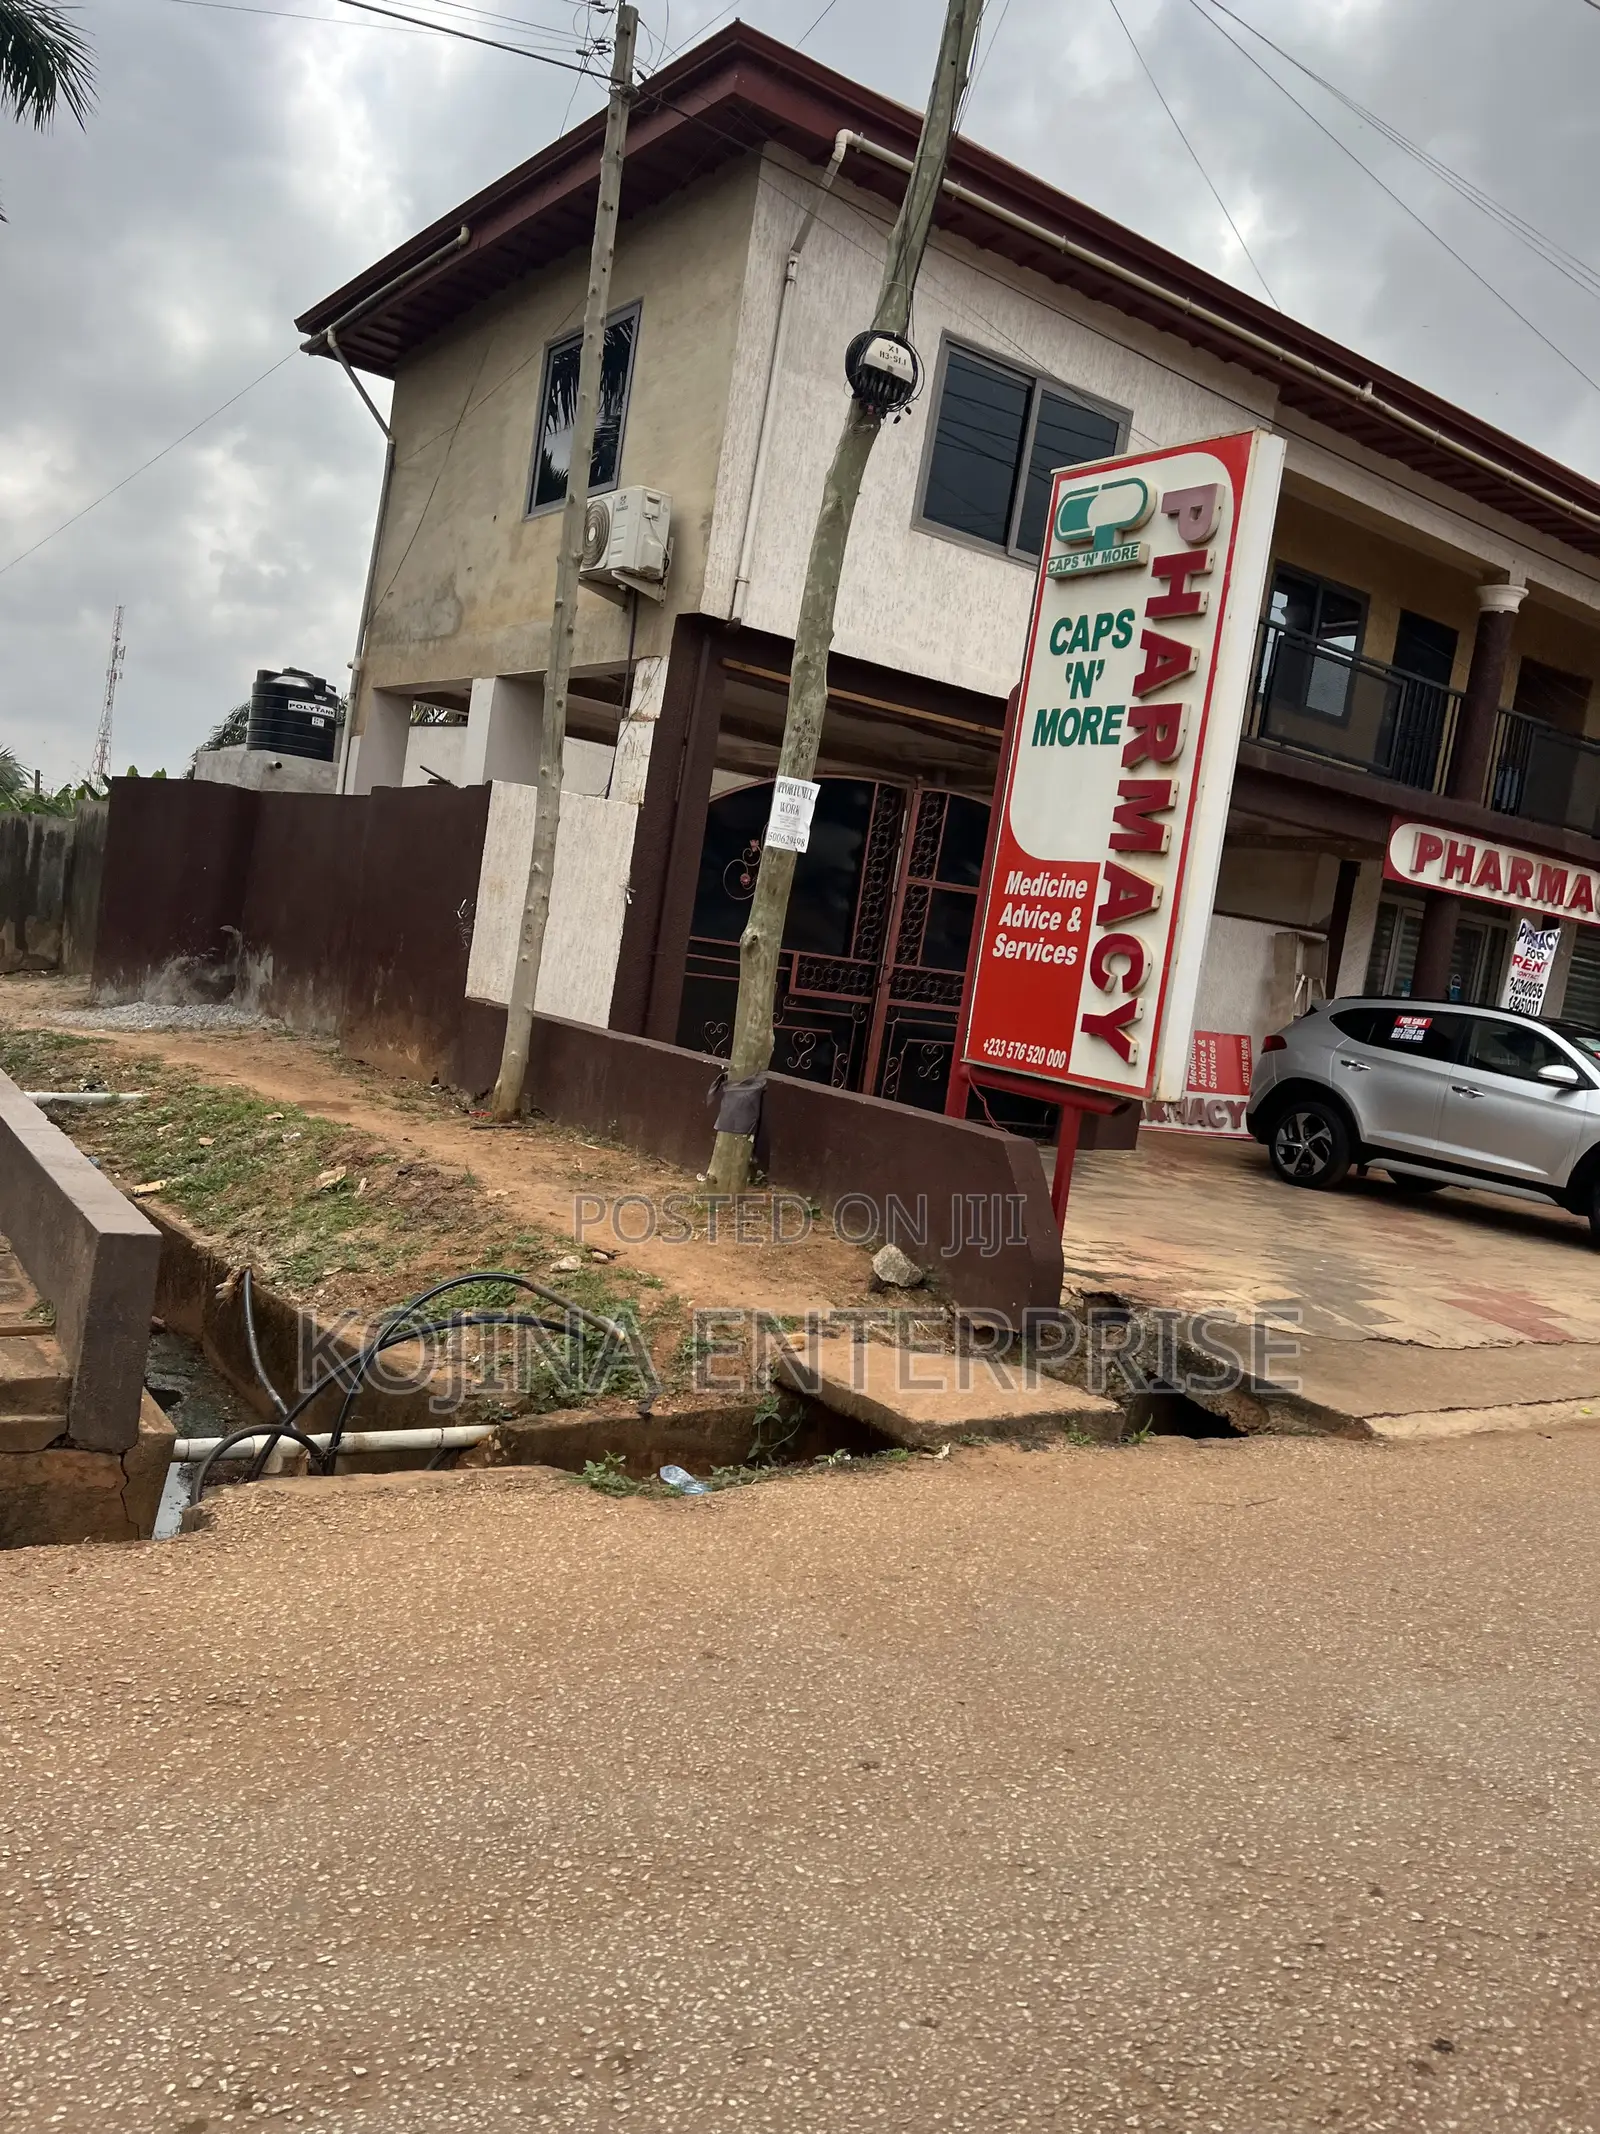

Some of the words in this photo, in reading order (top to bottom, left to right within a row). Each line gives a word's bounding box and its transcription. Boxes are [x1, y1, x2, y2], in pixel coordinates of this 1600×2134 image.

[1048, 556, 1079, 573] CAPS
[1101, 545, 1139, 563] MORE
[1049, 608, 1136, 656] CAPS
[1031, 704, 1126, 747] MORE
[1080, 482, 1226, 1067] PHARMACY
[1004, 870, 1088, 899] Medicine
[1409, 831, 1600, 917] PHARMA
[998, 902, 1062, 931] Advice
[1066, 906, 1082, 933] &
[992, 932, 1078, 966] Services
[1511, 954, 1549, 973] RENT
[1525, 947, 1545, 960] FOR
[983, 1037, 1004, 1057] +233
[1006, 1042, 1027, 1061] 576
[1026, 1046, 1046, 1066] 520
[1046, 1049, 1067, 1069] 000
[1197, 1039, 1207, 1048] &
[1198, 1050, 1208, 1088] Advice
[1208, 1040, 1218, 1089] Services
